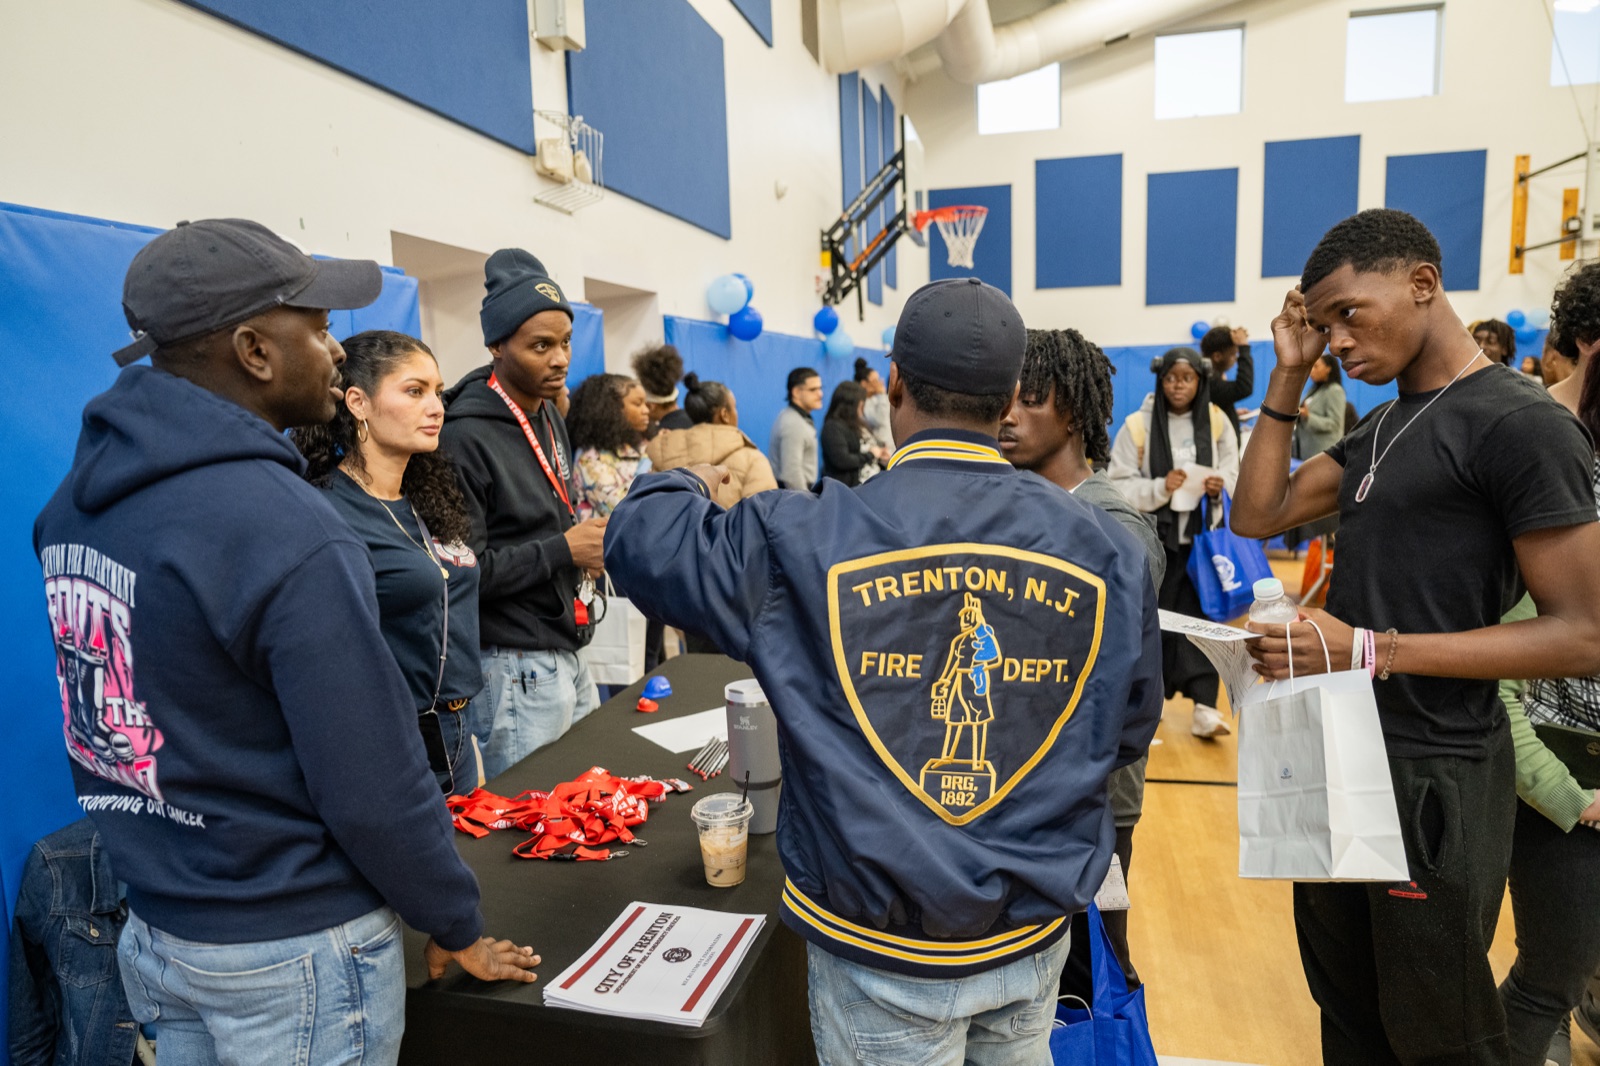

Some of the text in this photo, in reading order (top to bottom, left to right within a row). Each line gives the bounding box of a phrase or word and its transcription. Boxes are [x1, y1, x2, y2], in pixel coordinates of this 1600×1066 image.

[491, 380, 526, 424] TRENTON
[523, 424, 539, 447] FIRE
[66, 543, 85, 575] FIRE
[83, 545, 137, 608] DEPARTMENT
[852, 566, 1080, 617] TRENTON, N.J.
[860, 651, 1069, 683] FIRE DEPT.
[940, 774, 978, 791] ORG.
[147, 799, 166, 819] OUT
[166, 805, 206, 829] CANCER
[940, 791, 976, 807] 1892
[594, 912, 674, 994] CITY OF TRENTON
[613, 968, 638, 994] DEPARTMENT
